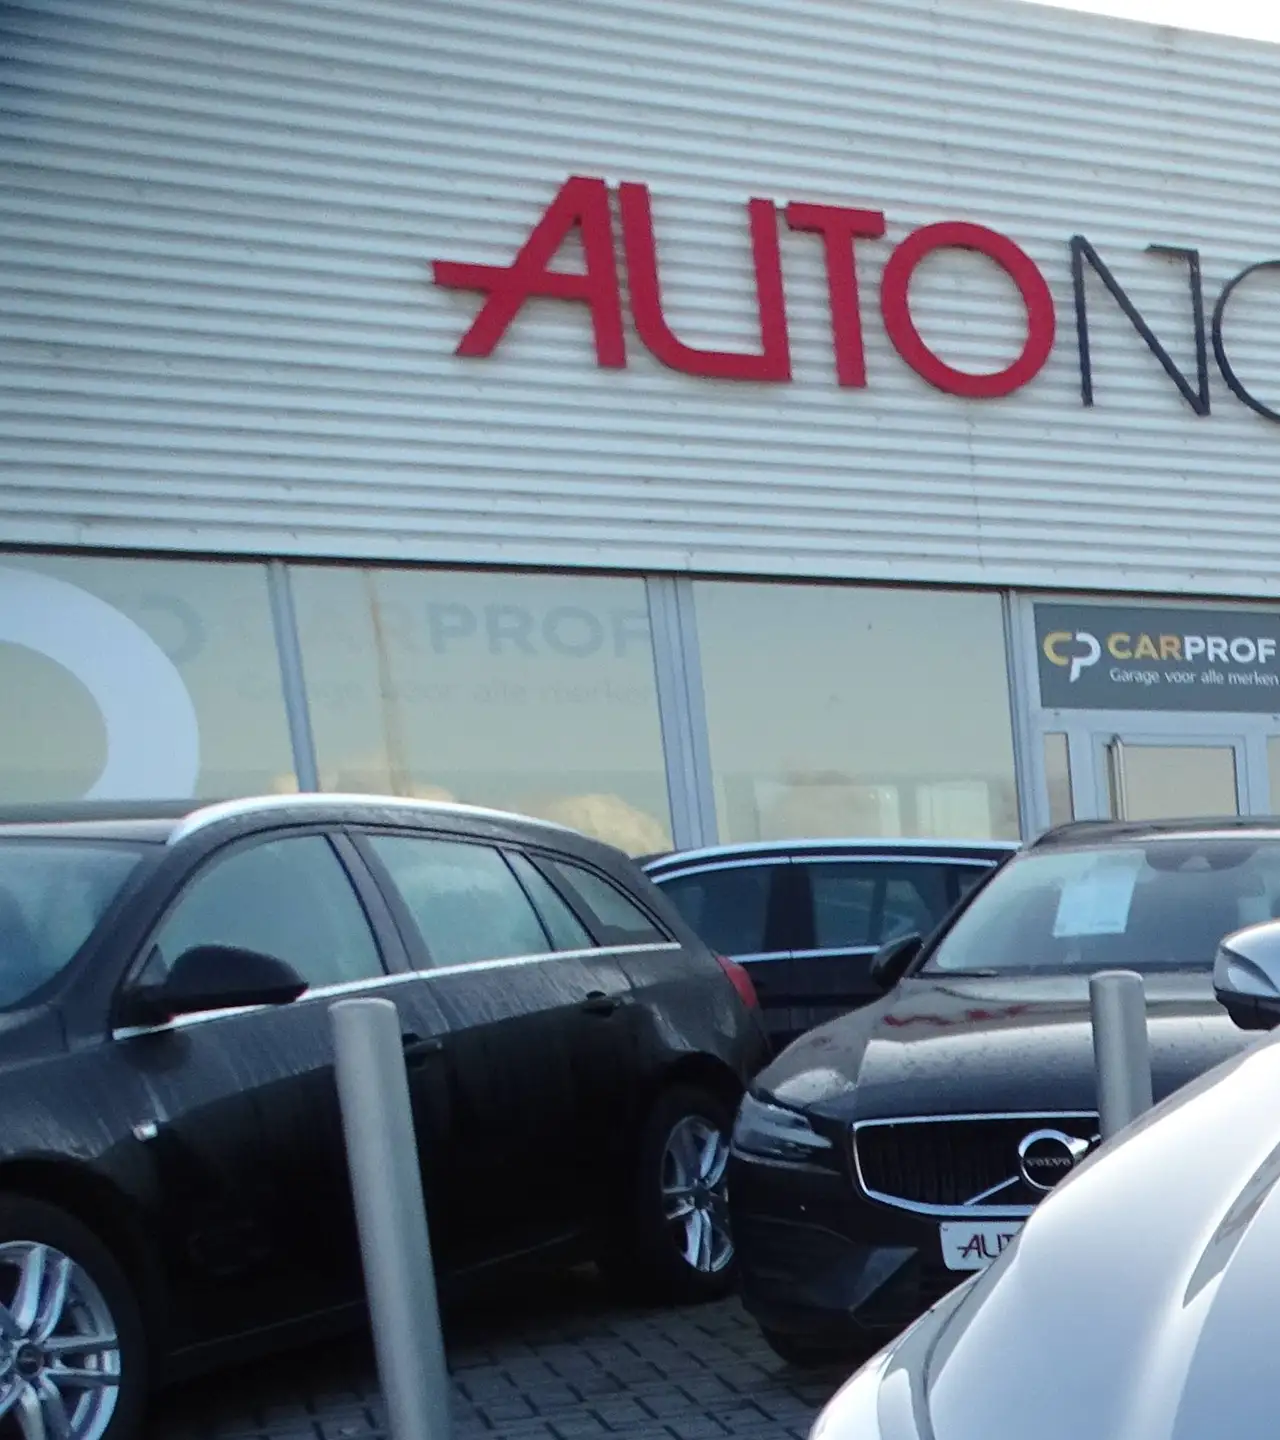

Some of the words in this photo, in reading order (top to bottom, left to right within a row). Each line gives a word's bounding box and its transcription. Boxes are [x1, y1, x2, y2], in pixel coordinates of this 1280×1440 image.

[1107, 631, 1276, 664] CARPROF
[1109, 667, 1160, 685] Garage
[1165, 671, 1196, 683] voor
[1200, 669, 1224, 684] alle
[1228, 671, 1280, 686] merken
[1026, 1156, 1071, 1167] VOLVO
